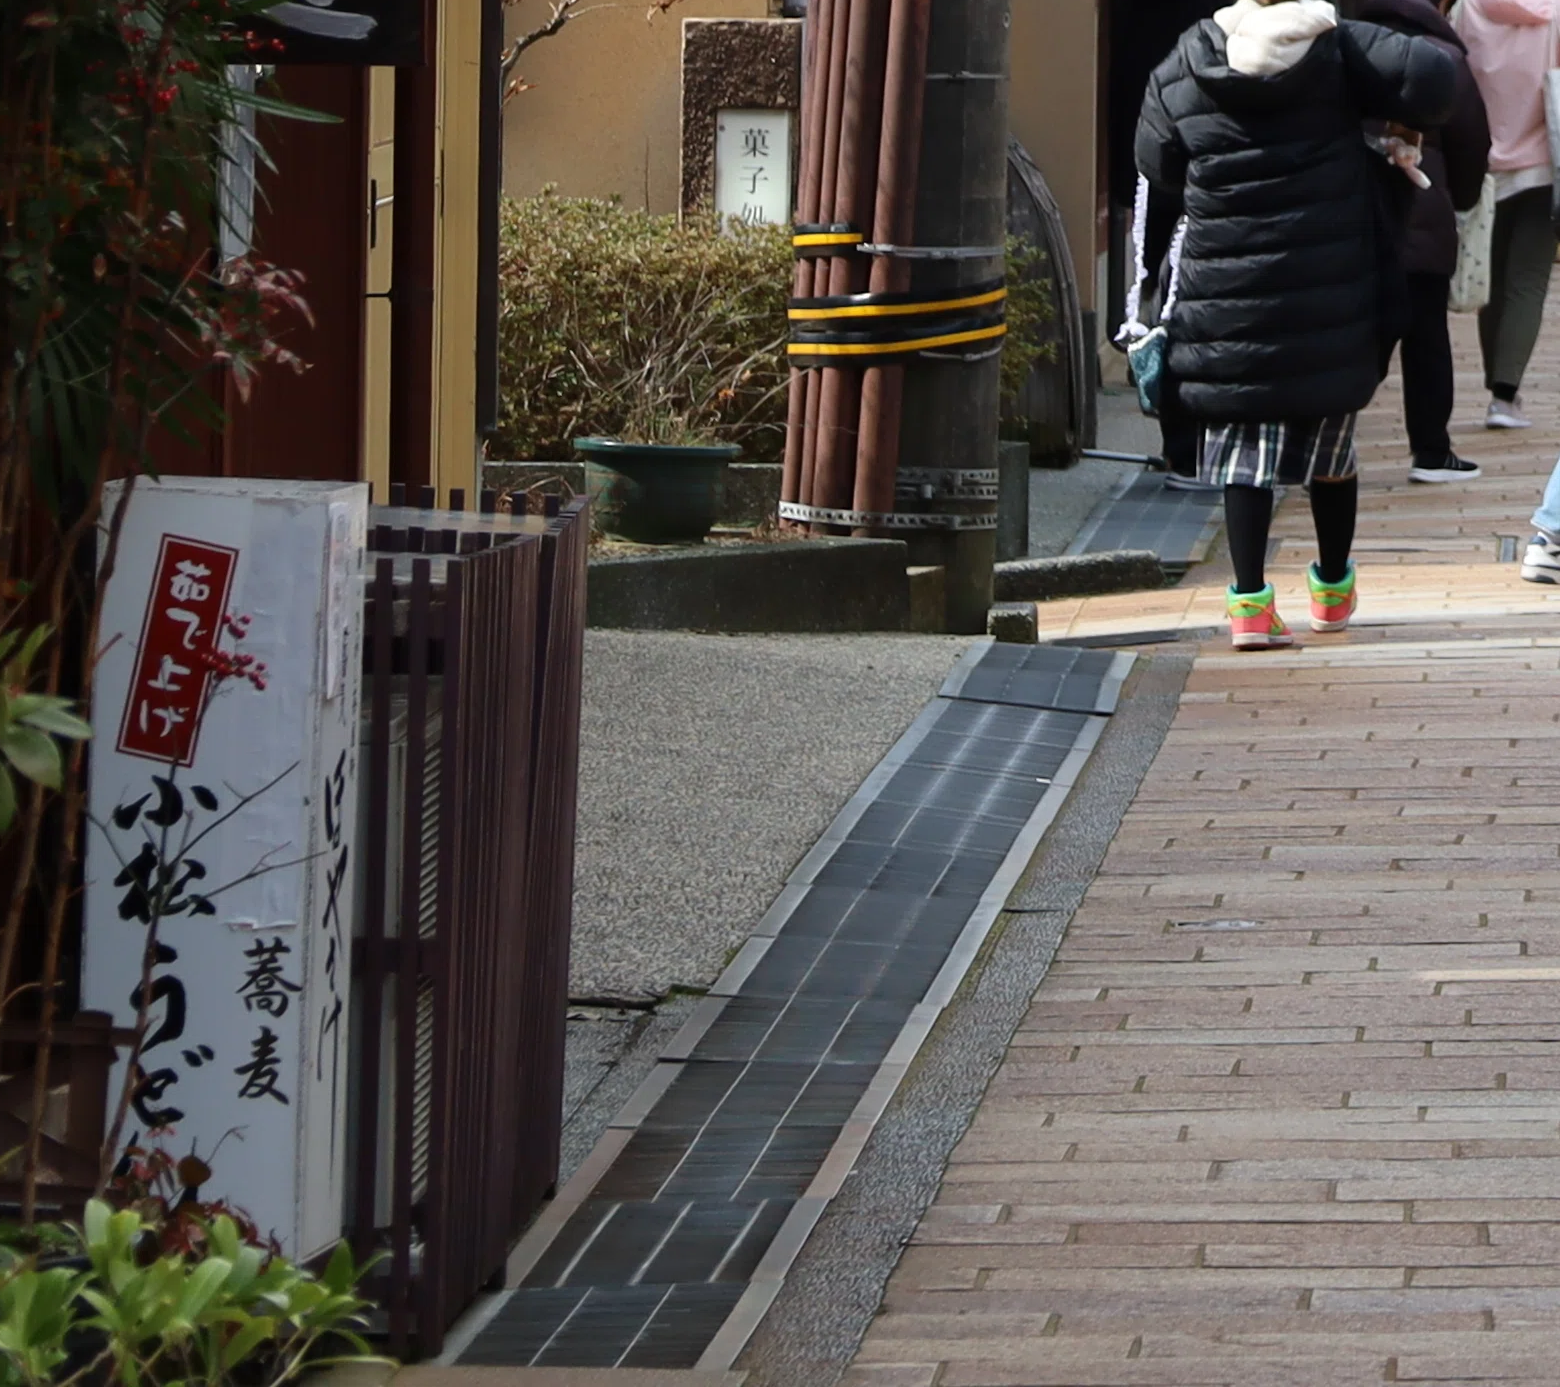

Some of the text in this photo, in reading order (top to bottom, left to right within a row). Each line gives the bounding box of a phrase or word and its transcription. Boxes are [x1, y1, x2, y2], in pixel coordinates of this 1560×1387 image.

[740, 127, 771, 227] 菓子処
[139, 560, 211, 738] 茹で上げ
[111, 774, 219, 1219] 小松うど
[234, 935, 302, 1106] 蕎麦
